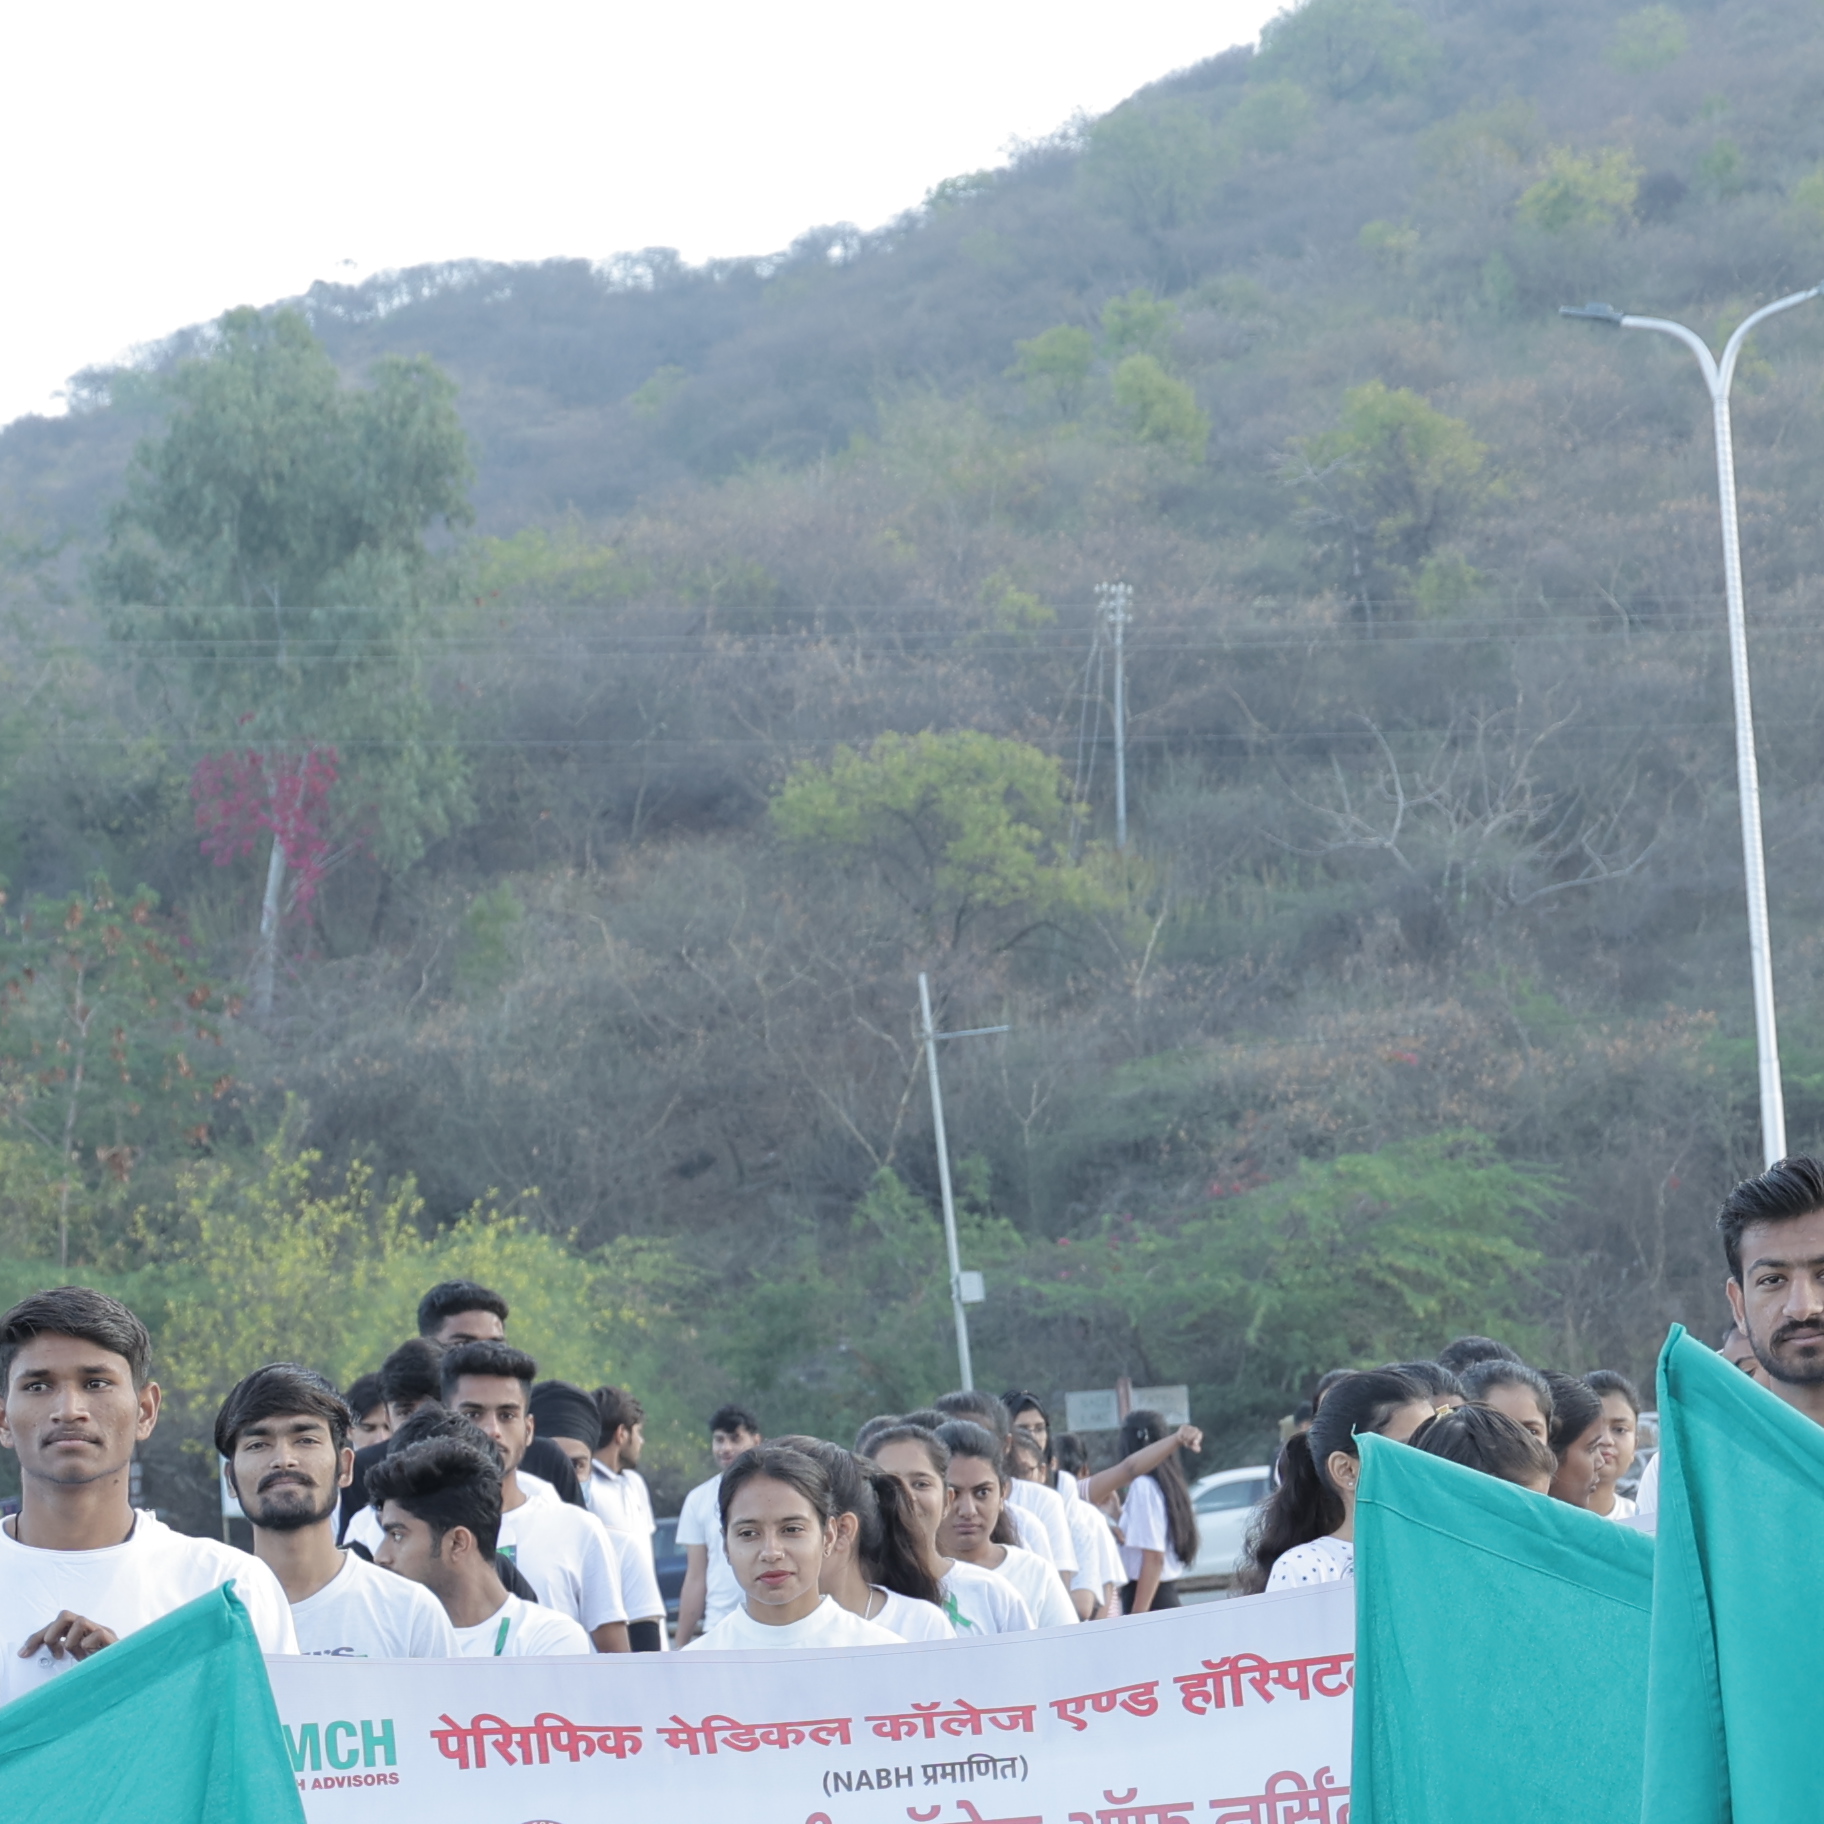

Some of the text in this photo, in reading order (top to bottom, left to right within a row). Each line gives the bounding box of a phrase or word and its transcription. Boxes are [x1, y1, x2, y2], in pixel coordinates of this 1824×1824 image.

[430, 1712, 643, 1769] पेसिफिक
[656, 1714, 853, 1756] मेडिकल
[864, 1698, 1037, 1742] कॉलेज
[1049, 1680, 1160, 1732] एण्ड
[311, 1772, 400, 1791] ADVISORS
[822, 1753, 1029, 1798] (NABH प्रमाणित)
